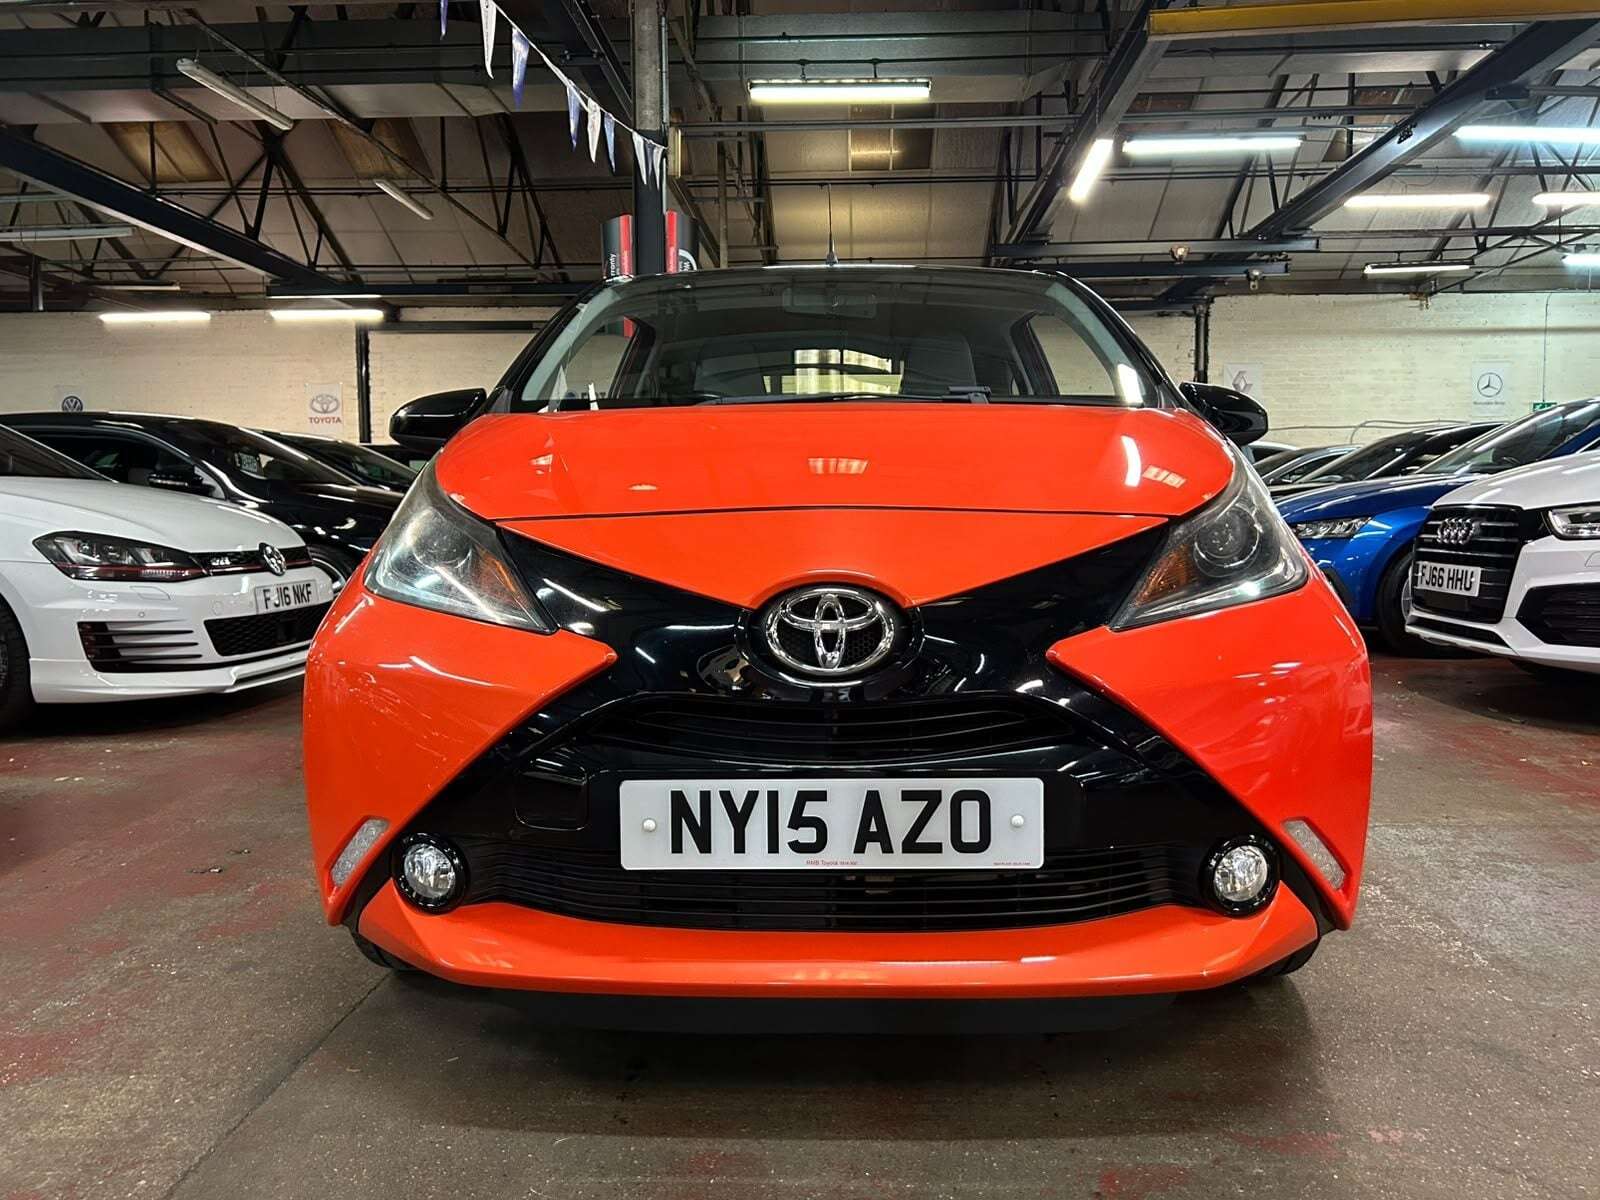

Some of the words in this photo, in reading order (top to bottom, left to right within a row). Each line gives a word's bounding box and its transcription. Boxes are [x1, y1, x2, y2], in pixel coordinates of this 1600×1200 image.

[308, 416, 342, 424] TOYOTA
[1420, 564, 1445, 588] FJ66
[1446, 568, 1475, 592] HHU
[262, 586, 291, 609] FJ16
[292, 583, 312, 605] NKF
[670, 789, 828, 854] NY15
[853, 789, 992, 854] AZO
